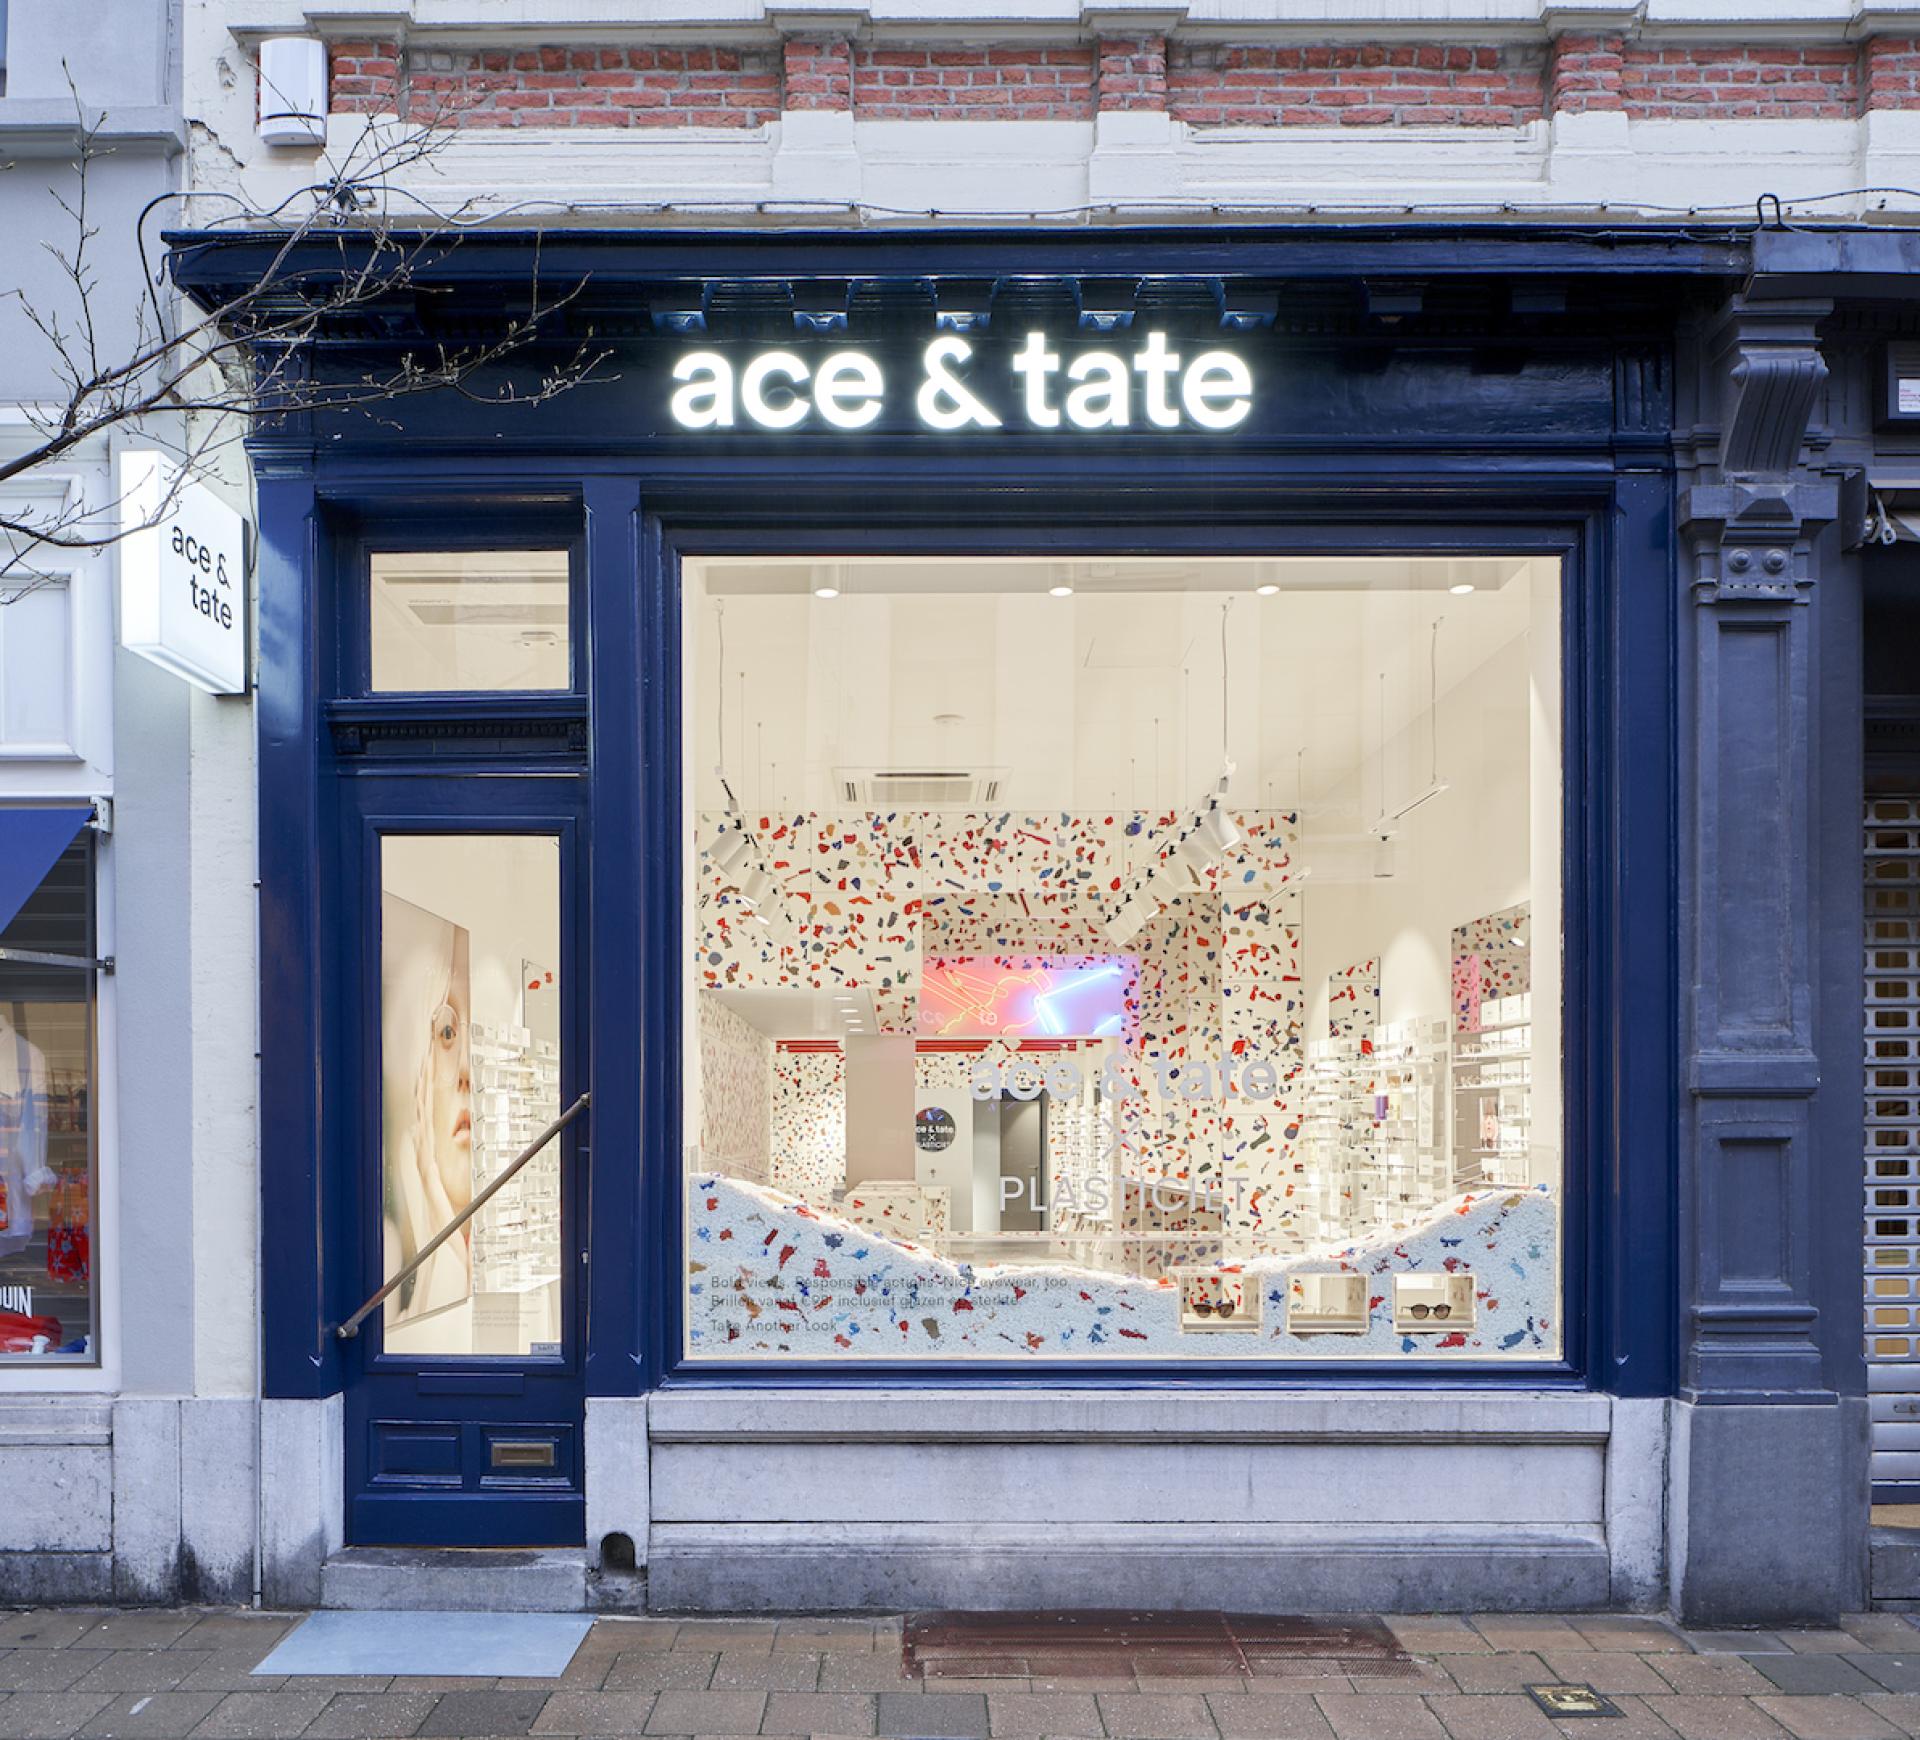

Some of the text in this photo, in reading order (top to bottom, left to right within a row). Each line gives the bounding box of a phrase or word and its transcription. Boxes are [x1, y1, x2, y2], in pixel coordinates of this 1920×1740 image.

[670, 331, 1254, 430] ace & tate
[172, 526, 231, 589] ace &
[190, 574, 233, 630] tate
[969, 1049, 1278, 1101] ace & tate
[999, 1176, 1250, 1213] PLASTICIET
[711, 1294, 754, 1308] Brille
[747, 1275, 790, 1289] vies.
[805, 1319, 837, 1332] Look
